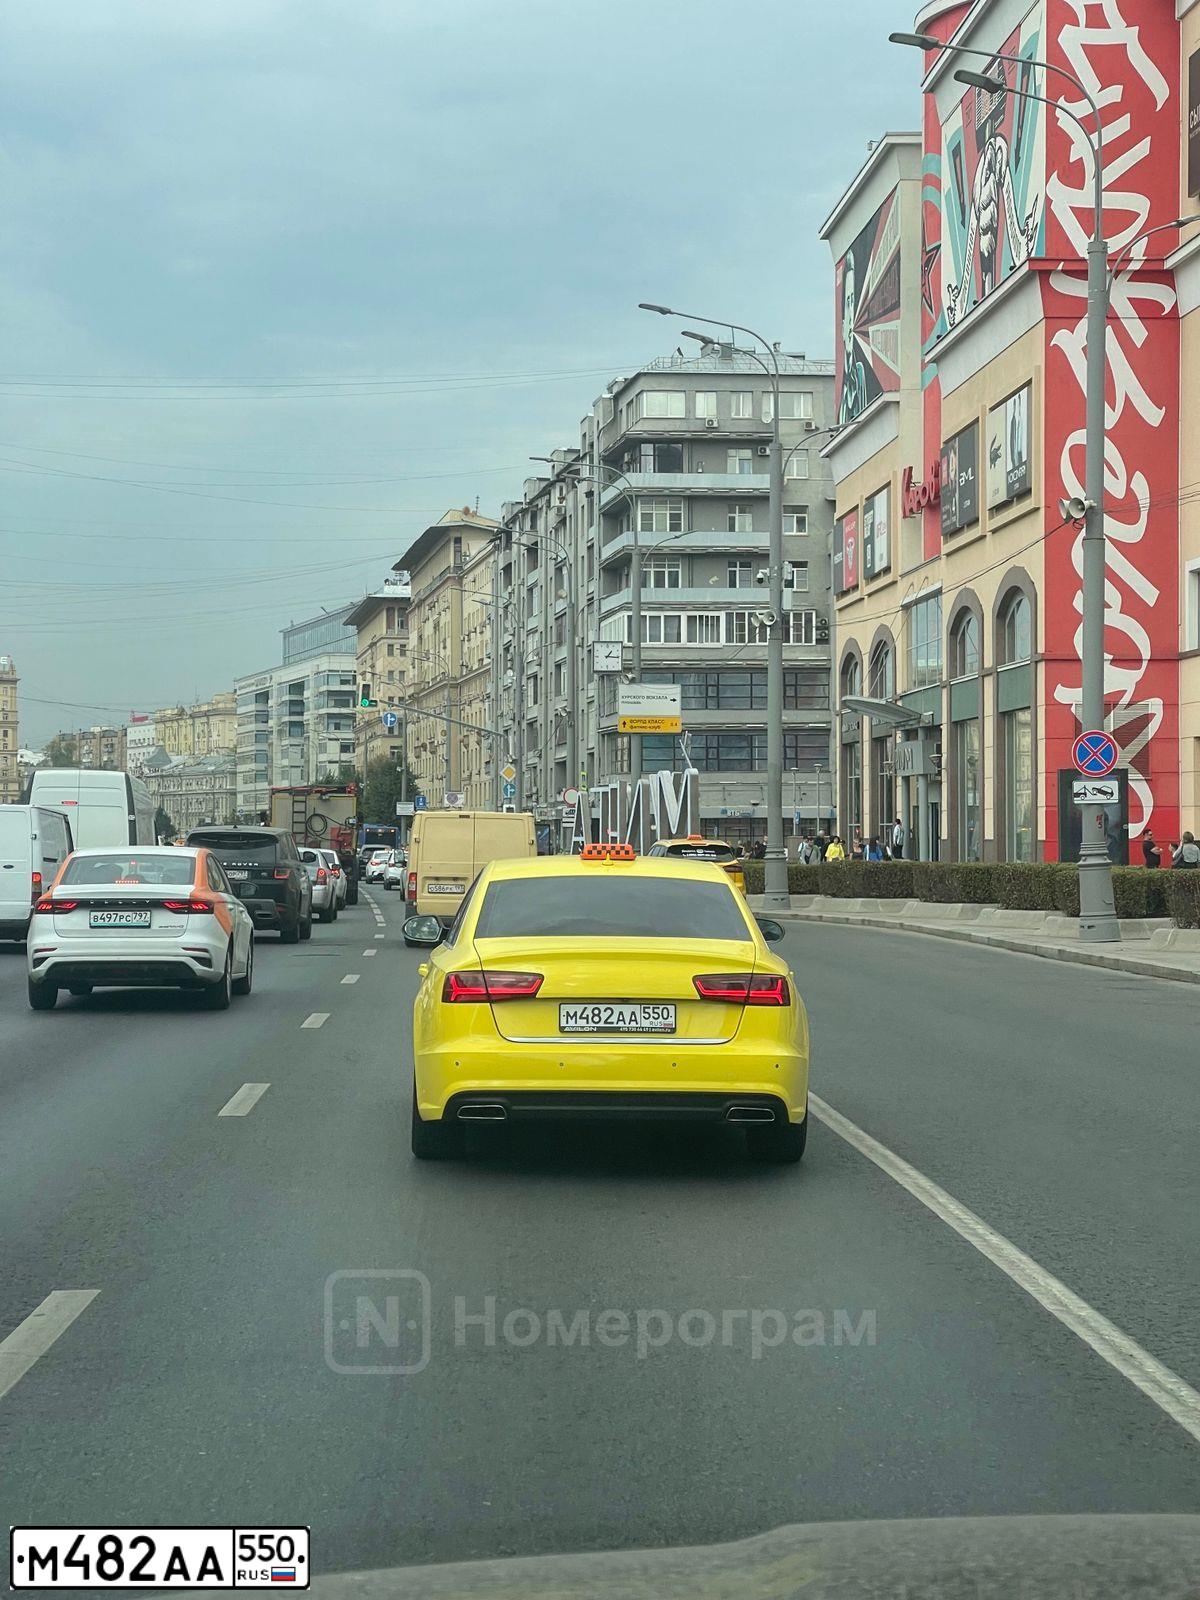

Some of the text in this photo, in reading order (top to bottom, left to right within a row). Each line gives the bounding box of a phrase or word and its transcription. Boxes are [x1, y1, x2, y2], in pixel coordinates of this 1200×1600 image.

[93, 912, 148, 923] В497РС 797
[565, 1006, 670, 1025] М482АА 550
